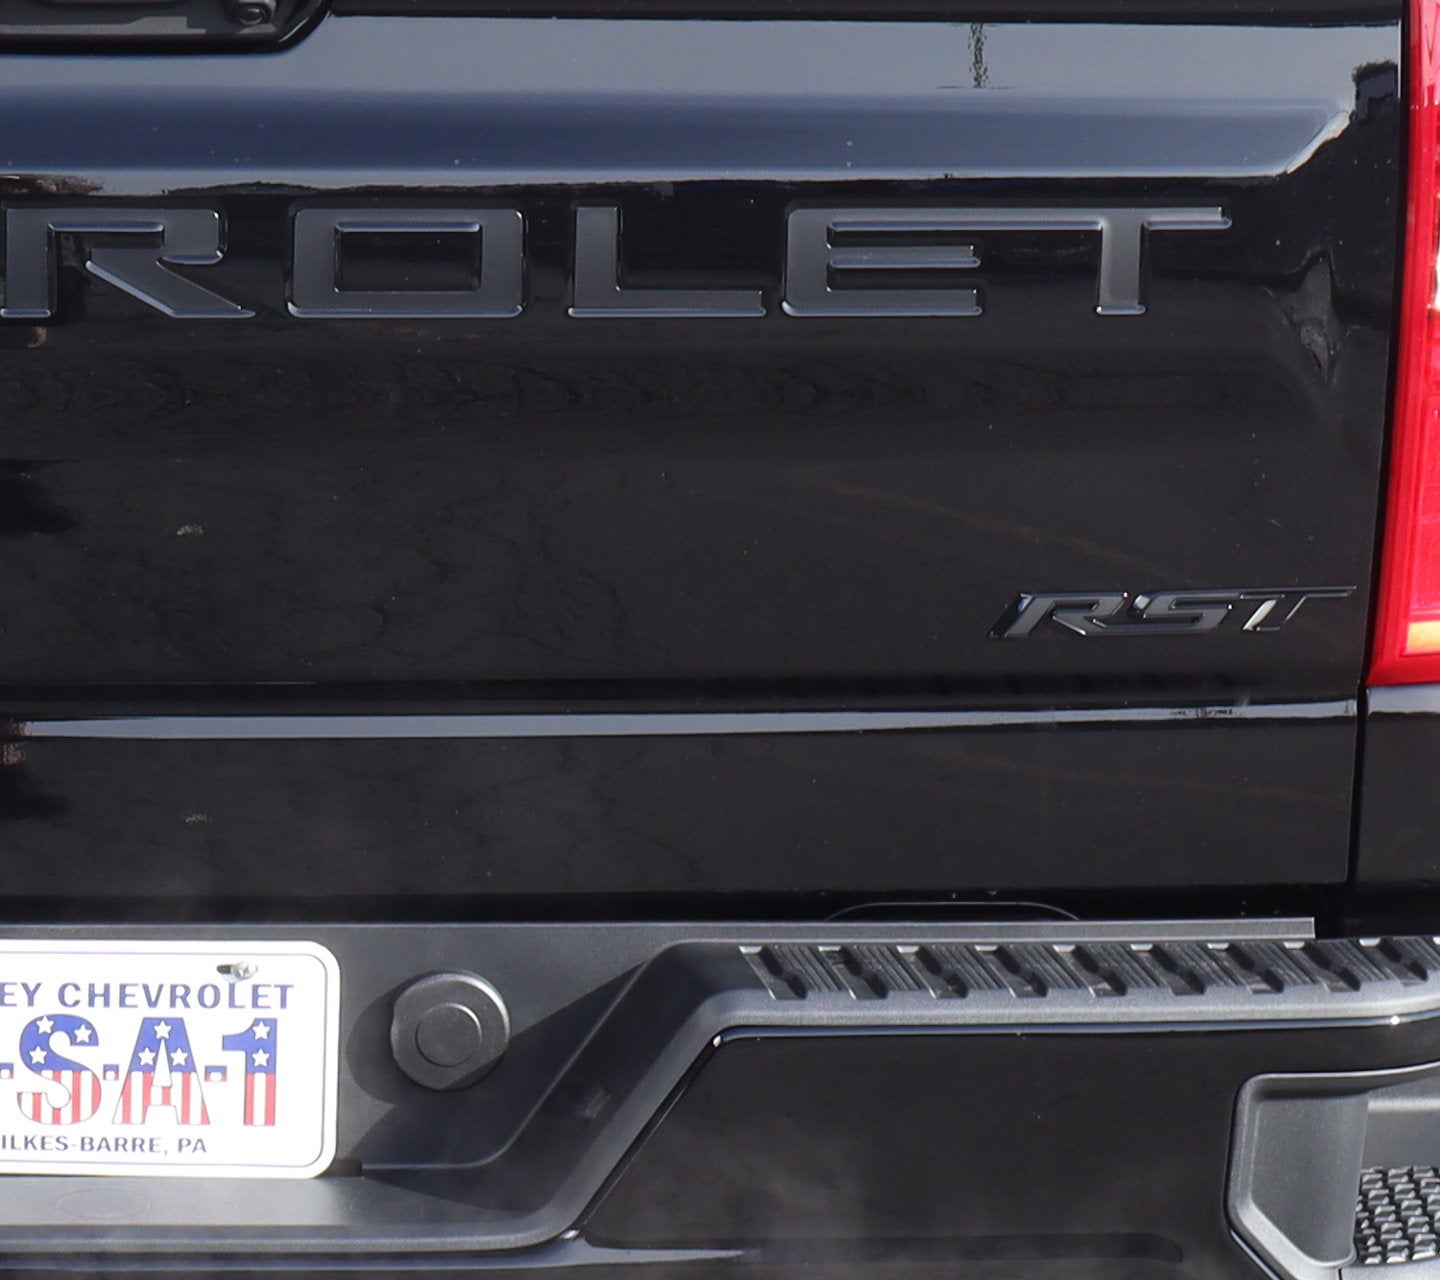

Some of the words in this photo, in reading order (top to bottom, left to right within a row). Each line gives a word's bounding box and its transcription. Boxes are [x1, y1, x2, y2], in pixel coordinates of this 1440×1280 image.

[986, 584, 1358, 638] RST
[57, 981, 295, 1010] CHEVROLET
[177, 1136, 208, 1154] PA
